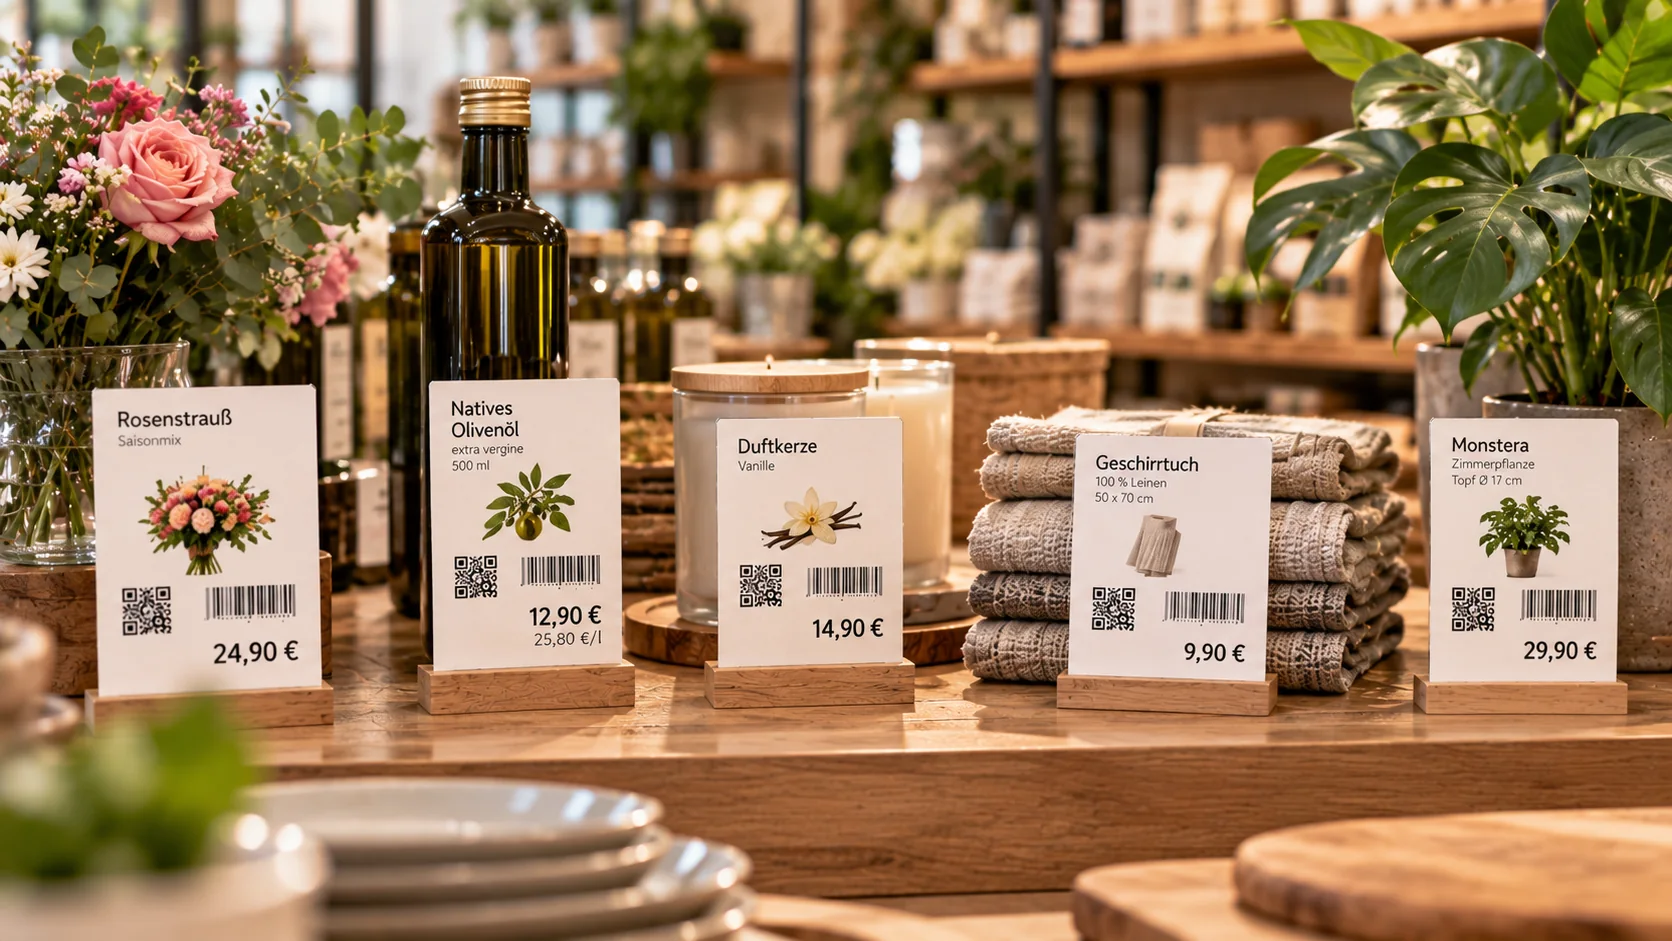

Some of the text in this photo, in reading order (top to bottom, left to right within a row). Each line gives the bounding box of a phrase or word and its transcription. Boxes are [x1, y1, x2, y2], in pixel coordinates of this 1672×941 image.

[451, 400, 513, 417] Natives
[117, 407, 233, 428] Rosenstrauß
[117, 433, 182, 448] Saisonmix
[738, 437, 818, 455] Duftkerze
[1451, 436, 1530, 453] Monstera
[451, 443, 524, 458] extra vergine
[452, 459, 490, 472] 500 ml
[737, 459, 776, 472] Vanille
[1095, 454, 1199, 473] Geschirrtuch
[1451, 457, 1536, 472] Zimmerpflanze
[1095, 475, 1168, 489] 100 % Leinen
[1451, 474, 1523, 489] Topf Ø 17 cm
[1094, 491, 1154, 504] 50 x 70 cm
[529, 604, 602, 630] 12,90 €
[812, 617, 884, 642] 14,90 €
[534, 629, 602, 648] 25,80 €/l
[213, 639, 299, 667] 24,90 €
[1183, 642, 1246, 664] 9,90 €
[1523, 640, 1598, 663] 29,90 €
